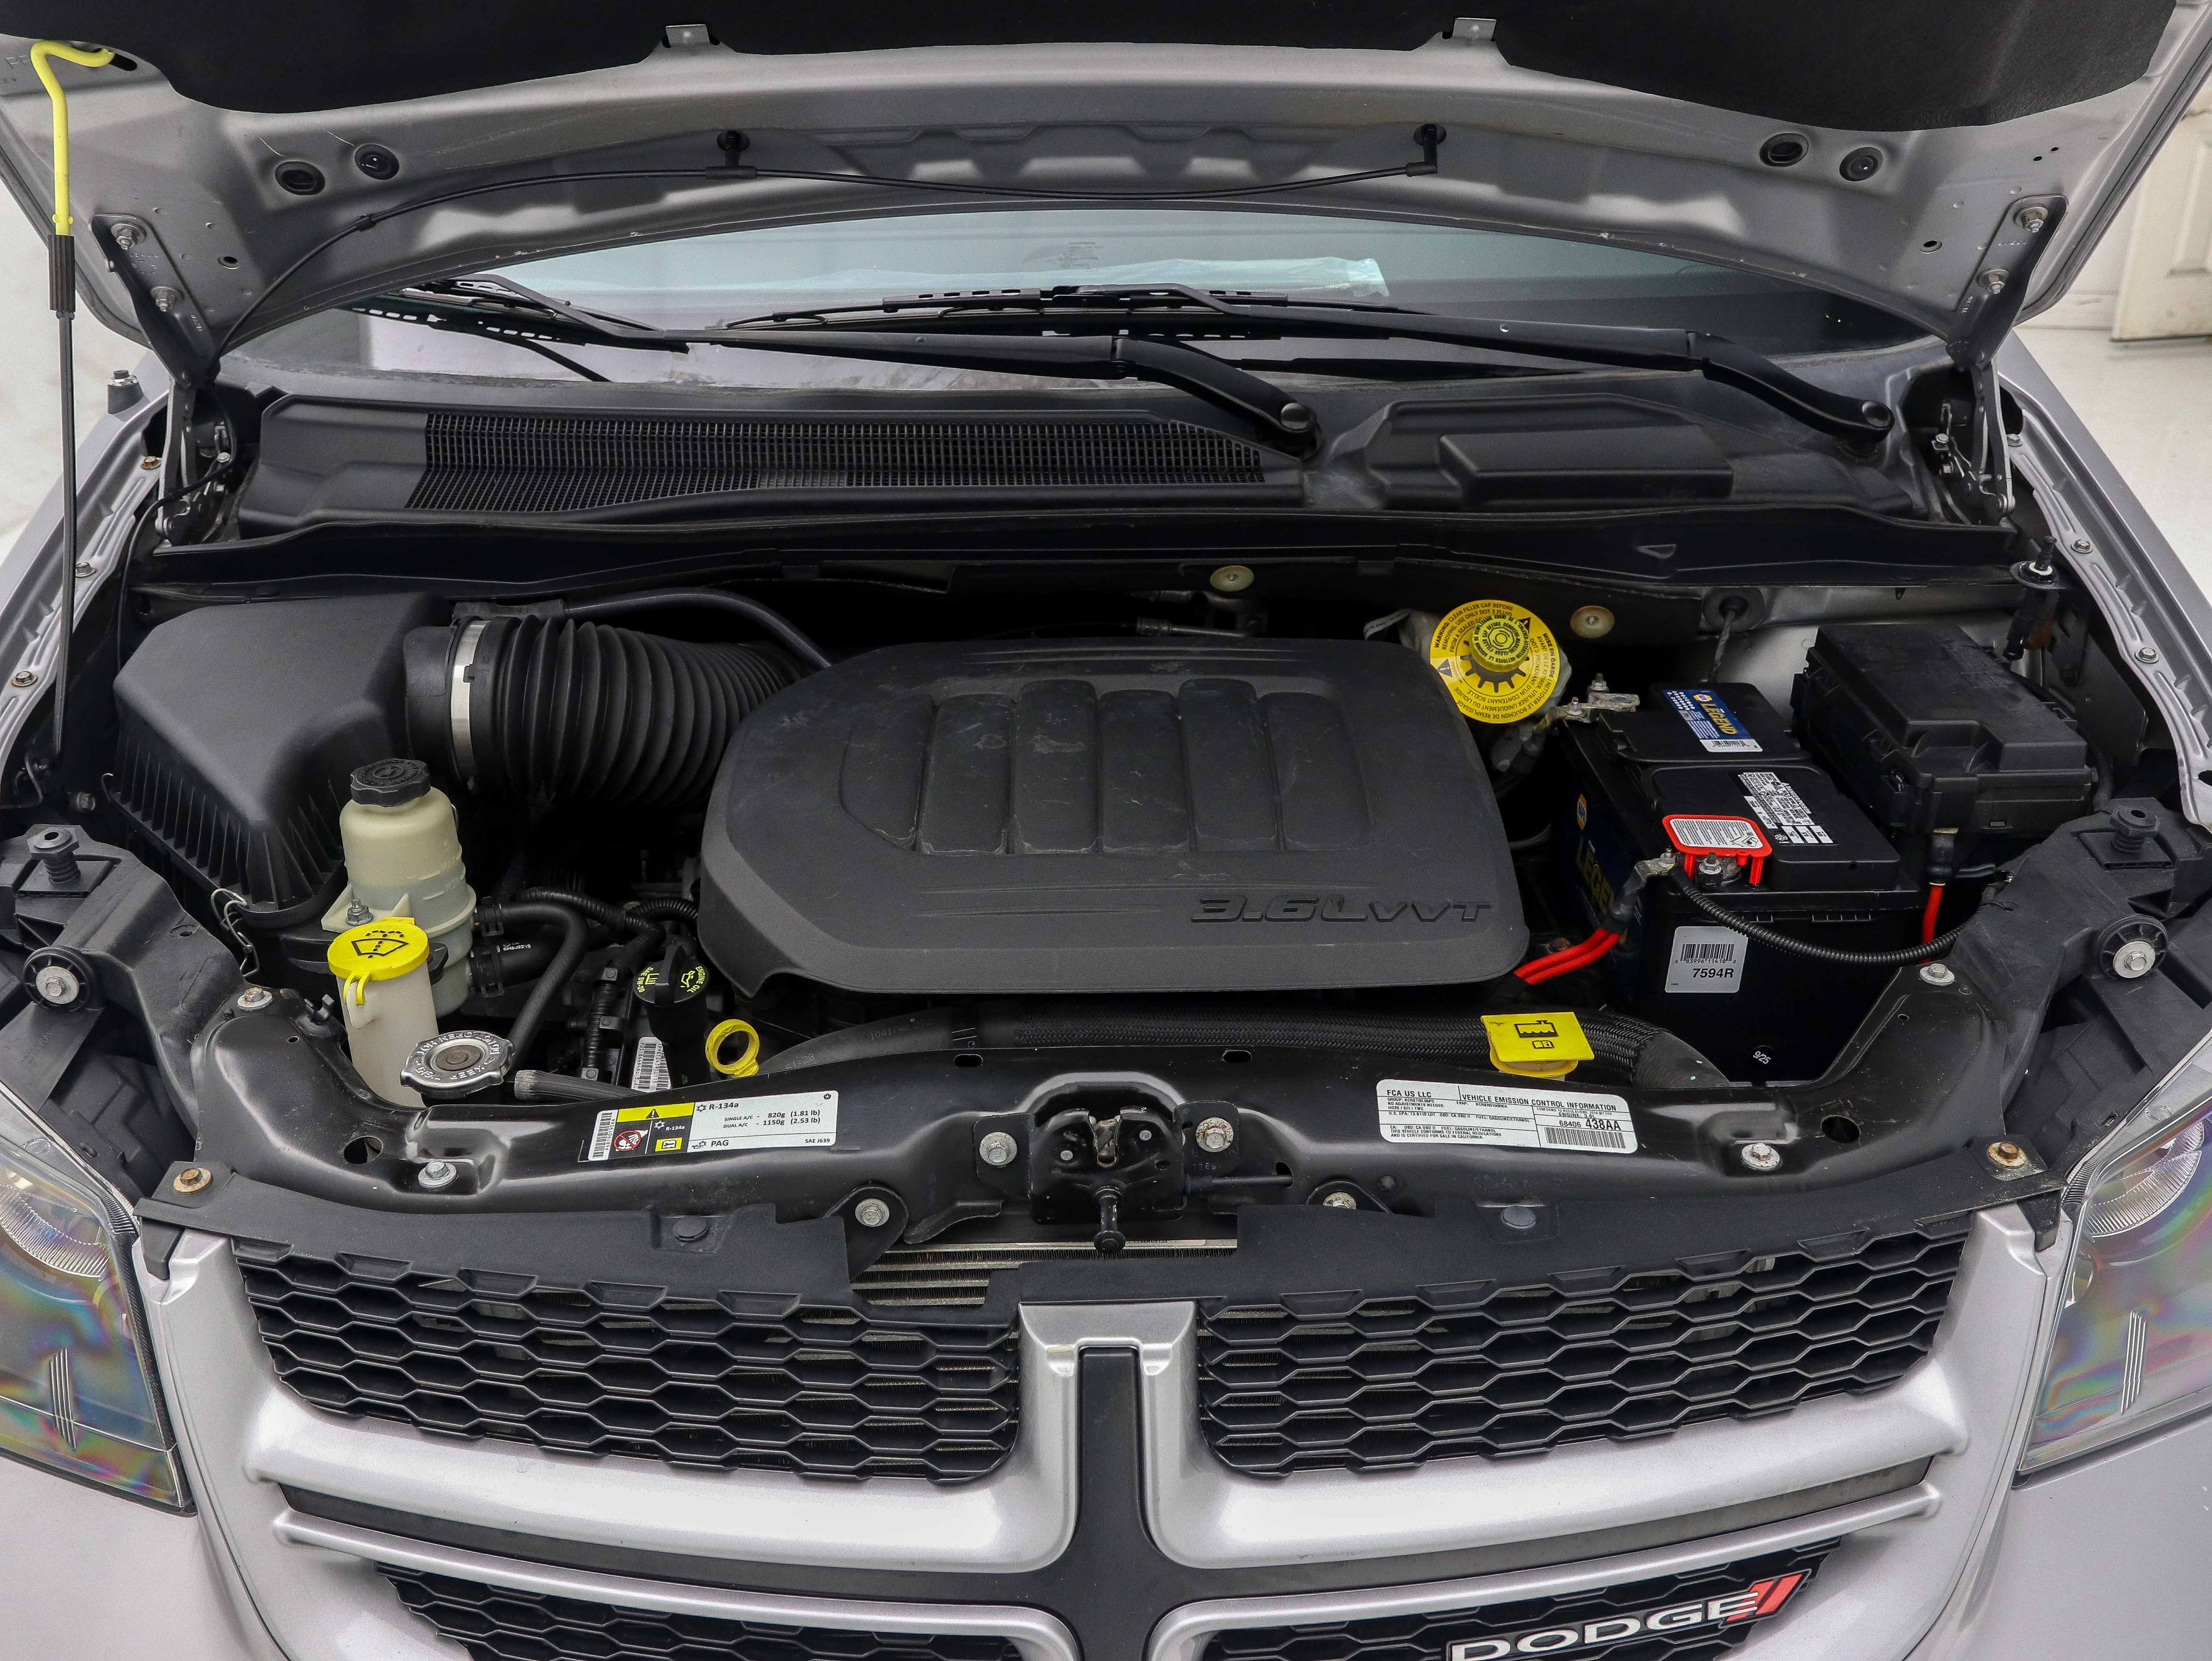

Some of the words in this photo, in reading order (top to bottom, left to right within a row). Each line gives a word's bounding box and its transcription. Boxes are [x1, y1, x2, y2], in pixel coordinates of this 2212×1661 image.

[1455, 617, 1465, 625] USE
[1465, 610, 1478, 619] ONLY
[1434, 621, 1450, 648] WARNING:
[1449, 610, 1463, 622] CLEAN
[1463, 604, 1480, 612] FILLER
[1458, 621, 1474, 635] SEALED
[1529, 638, 1538, 649] DOT
[1537, 636, 1547, 652] AVANT
[1542, 633, 1553, 647] MISE
[1531, 654, 1541, 685] PROVENANT
[1453, 687, 1472, 703] LIQUIDE
[1520, 685, 1532, 696] D'UN
[1534, 682, 1551, 705] NETTOYER
[1488, 695, 1520, 704] CONTENANT
[1518, 691, 1537, 706] UTILISER
[1456, 700, 1491, 718] REMPLISSAGE
[1501, 707, 1527, 719] BOUCHON
[1701, 703, 1737, 735] LEGEND
[641, 967, 653, 976] SAE
[695, 966, 705, 985] ENGINE
[1693, 968, 1734, 978] 7594R
[637, 977, 645, 993] 5W-20
[687, 985, 700, 993] OIL
[1753, 1051, 1771, 1064] 9/25
[1567, 1102, 1616, 1111] INFORMATION
[1586, 1119, 1621, 1131] 438AA
[605, 1119, 616, 1151] P68190190AA
[1451, 1591, 1759, 1661] DODGE
